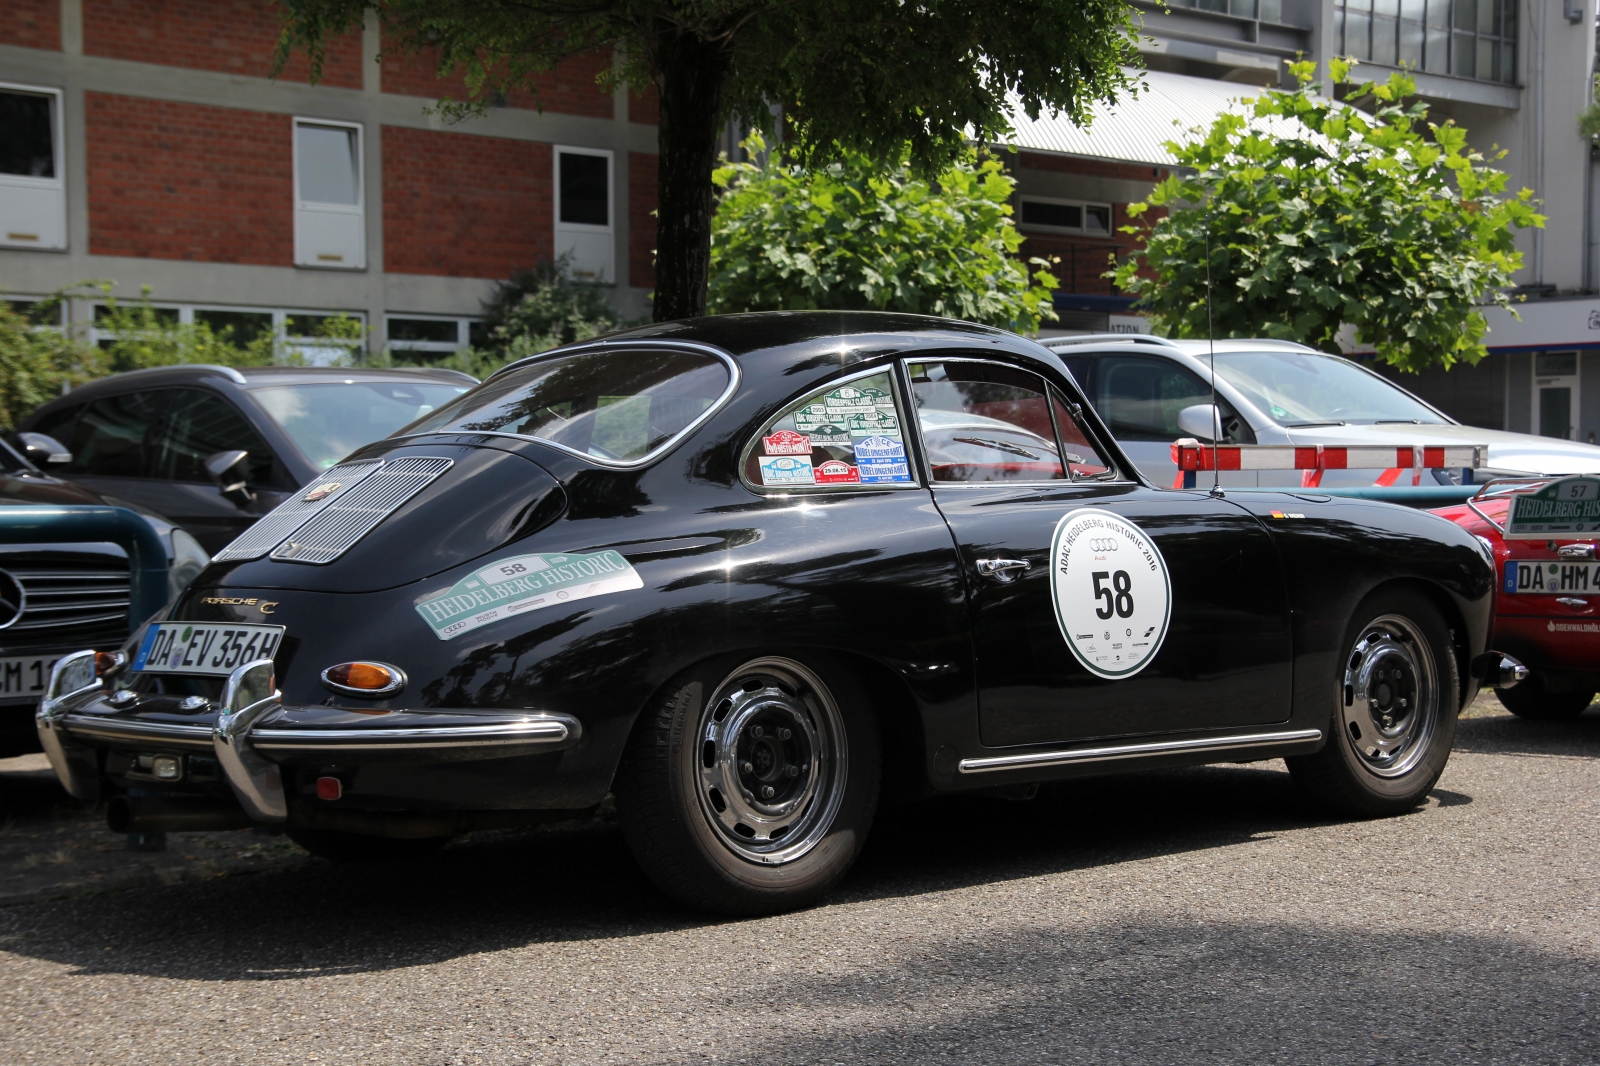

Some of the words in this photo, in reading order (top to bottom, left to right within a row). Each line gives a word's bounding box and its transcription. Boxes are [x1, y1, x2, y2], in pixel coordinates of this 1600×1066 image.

[826, 397, 855, 407] VORDERPFALZ
[855, 395, 873, 406] CLASSIC
[856, 446, 902, 457] NIBELUNGENFAHRT
[860, 464, 906, 476] NIBELUNGENFAHRT
[1571, 485, 1587, 498] 57
[1516, 496, 1581, 518] HEIDELBERG
[1065, 519, 1104, 547] HEIDELBERG
[1106, 520, 1144, 549] HISTORIC
[500, 563, 527, 576] 58
[1060, 545, 1071, 575] ADAC
[1143, 549, 1158, 571] 2016
[423, 575, 542, 622] HEIDELBERG
[540, 552, 626, 585] HISTORIC
[1518, 565, 1544, 590] DA
[1560, 565, 1588, 590] HM
[201, 597, 259, 606] PORSCHE
[1092, 570, 1134, 620] 58
[1556, 623, 1600, 632] ODENWALDHÖL
[146, 629, 177, 667] DA
[182, 629, 218, 667] EV
[212, 630, 279, 669] 356H
[0, 661, 22, 693] M
